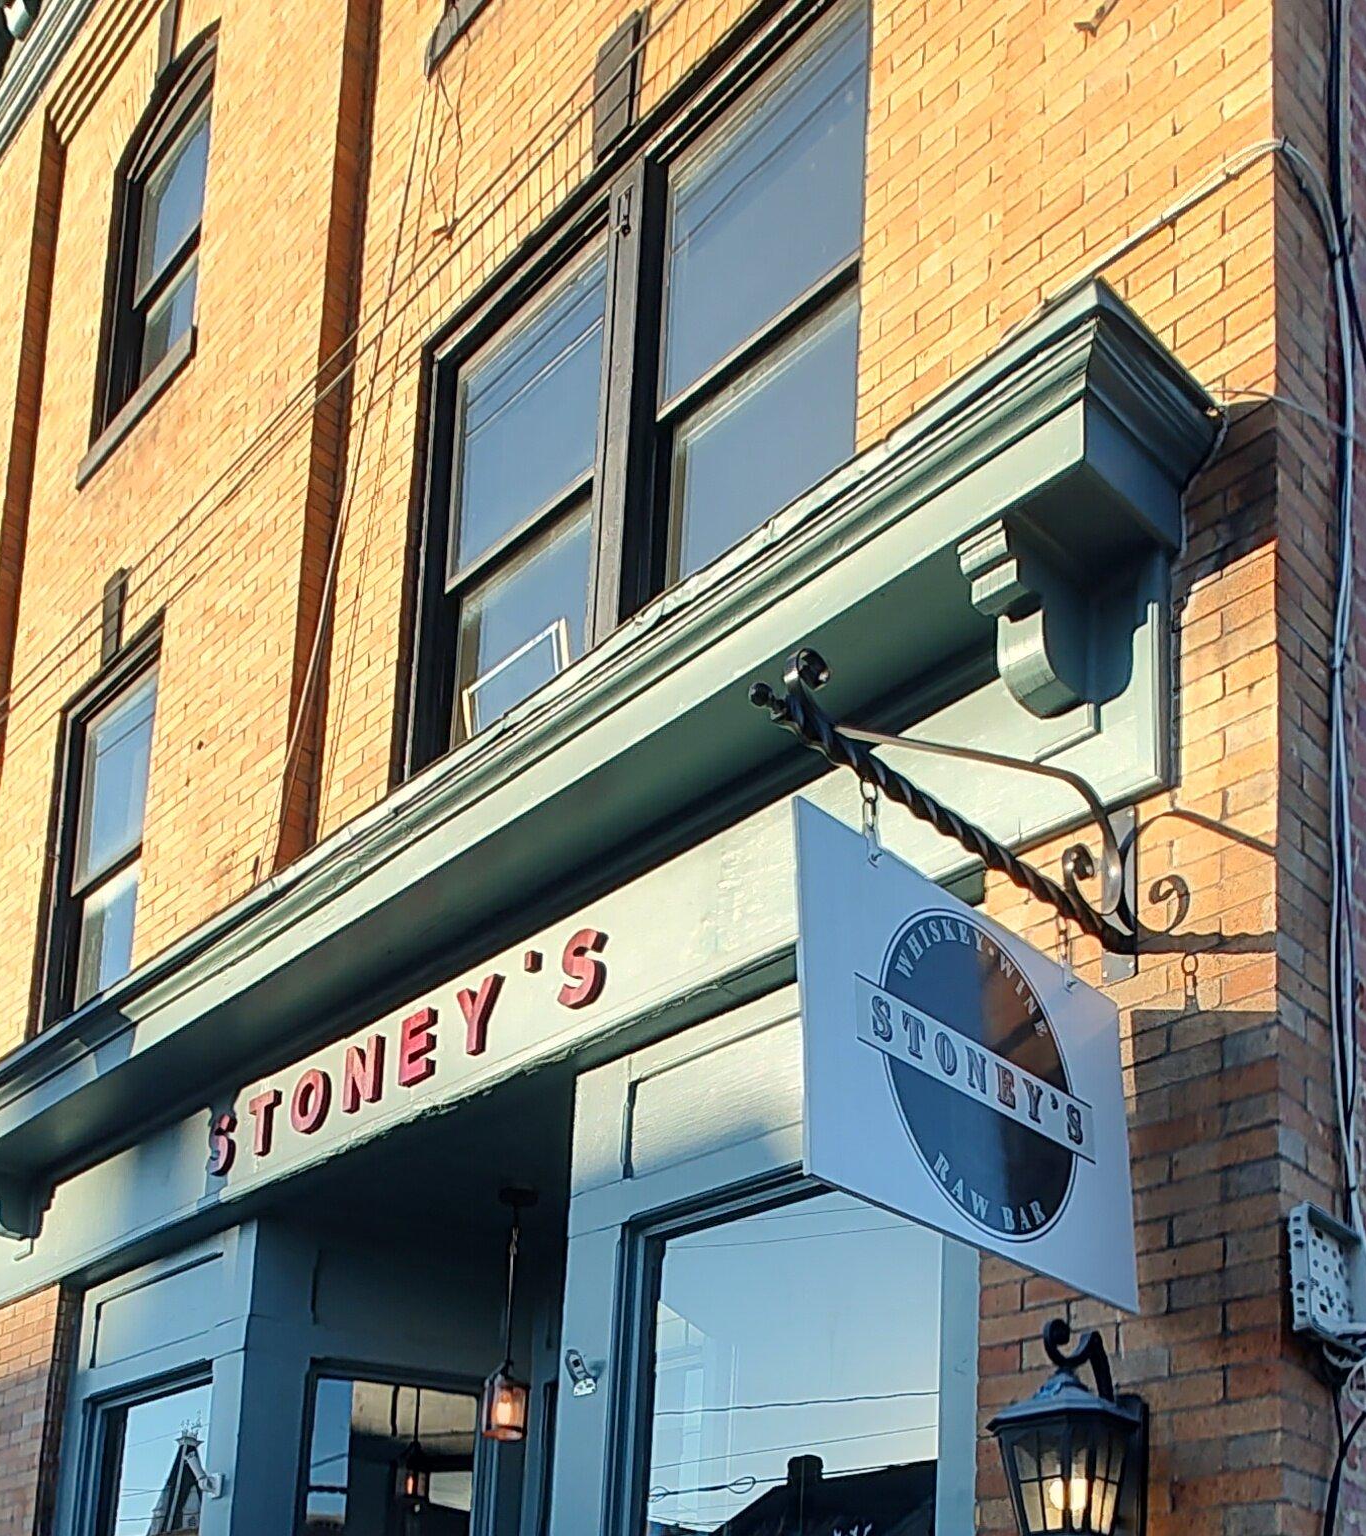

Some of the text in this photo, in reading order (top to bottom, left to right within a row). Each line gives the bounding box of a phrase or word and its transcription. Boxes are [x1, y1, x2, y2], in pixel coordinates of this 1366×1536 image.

[894, 916, 1049, 1038] WHISKEY WINE
[208, 928, 609, 1177] STONEY'S
[870, 994, 1084, 1146] STONEY'S
[933, 1150, 1048, 1232] RAW BAR
